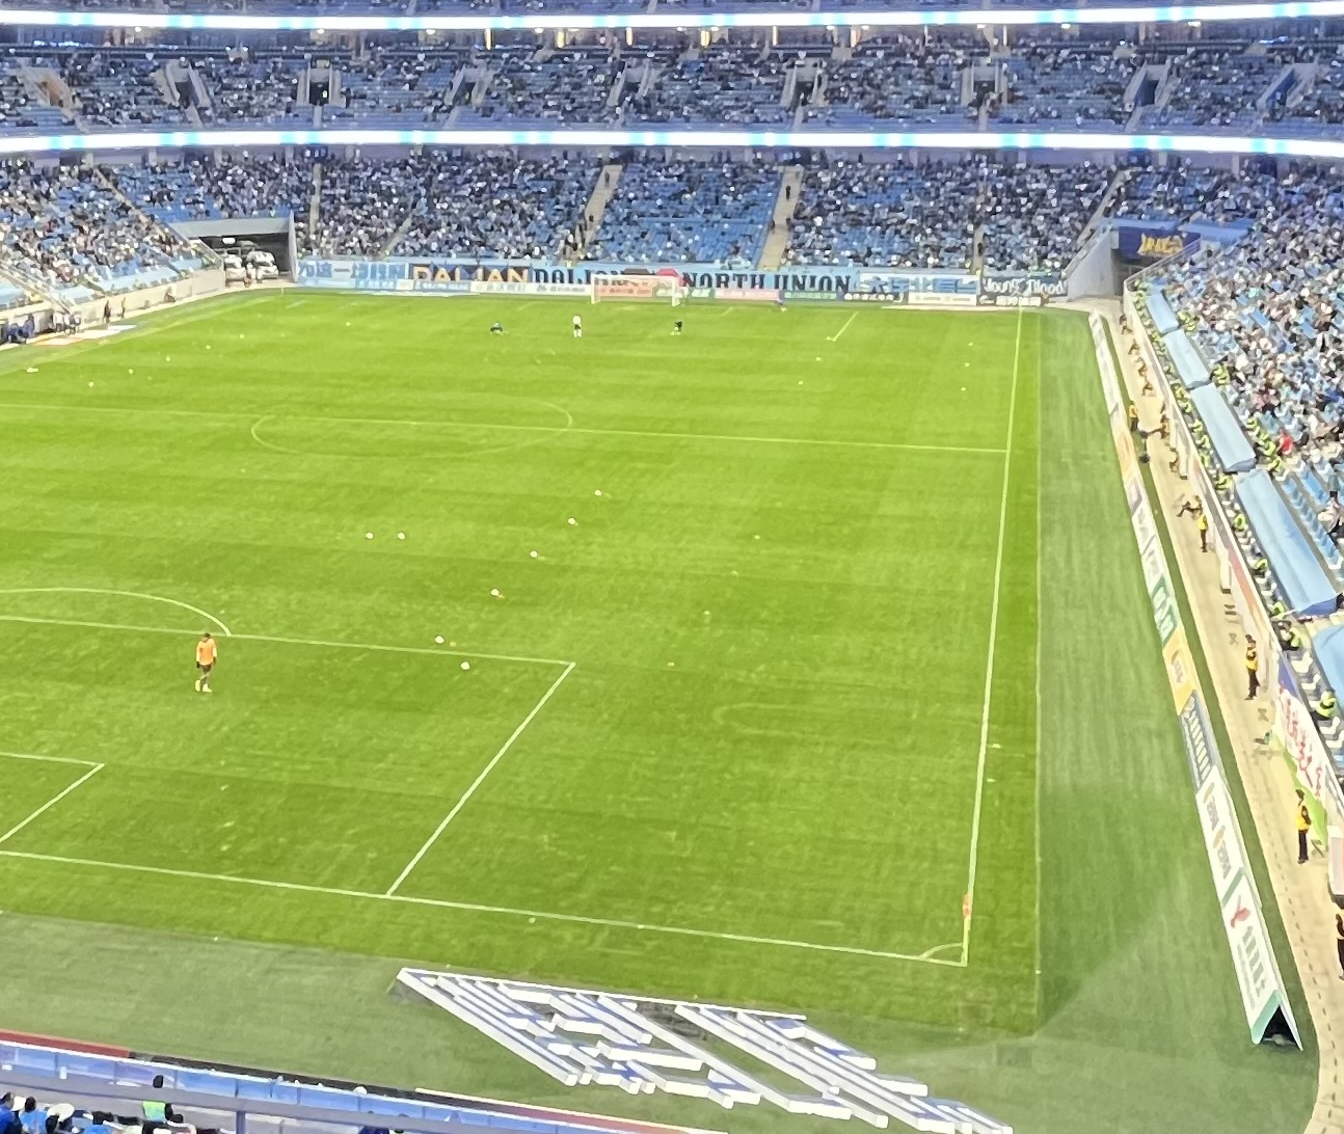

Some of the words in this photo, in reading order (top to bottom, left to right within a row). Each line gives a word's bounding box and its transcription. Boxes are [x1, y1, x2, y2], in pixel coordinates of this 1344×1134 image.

[413, 265, 529, 283] DALIAN
[682, 272, 766, 289] NORTH
[773, 274, 852, 293] UNION
